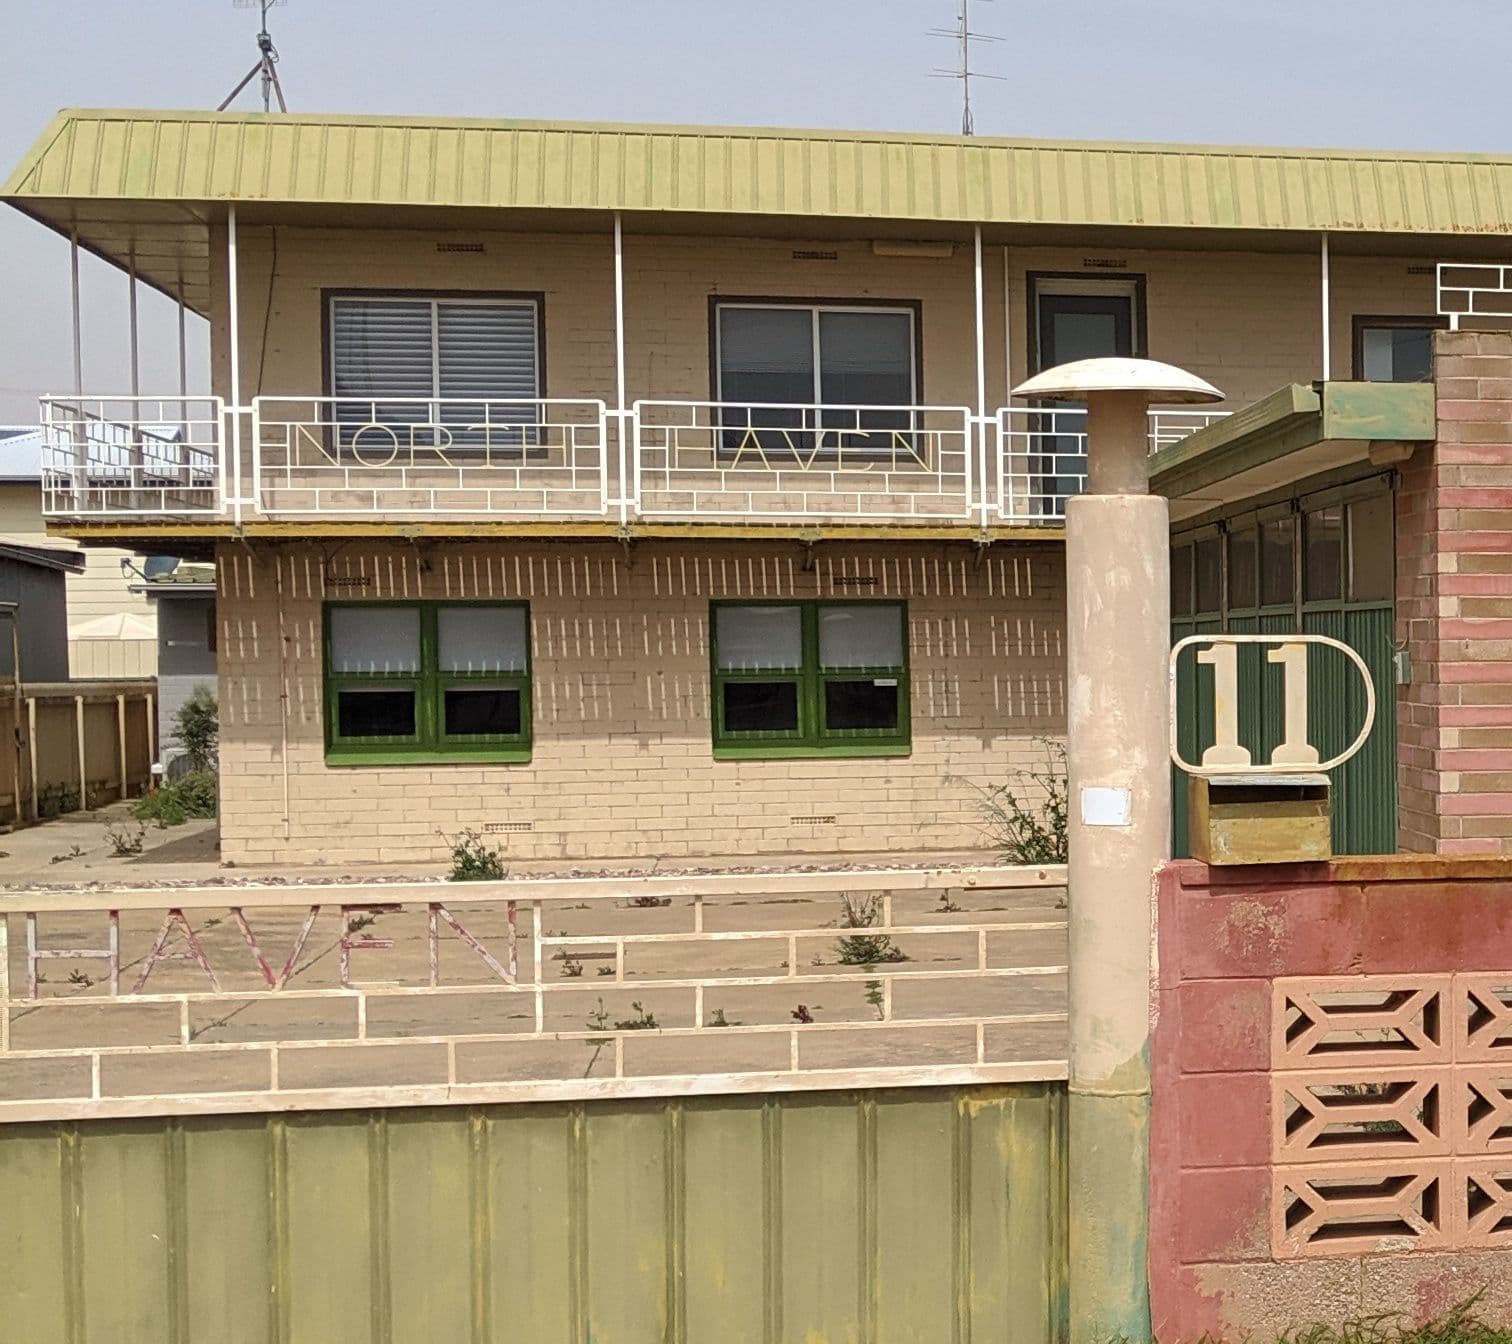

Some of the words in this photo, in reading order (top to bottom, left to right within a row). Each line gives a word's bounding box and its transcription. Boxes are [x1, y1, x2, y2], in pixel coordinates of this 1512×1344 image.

[675, 426, 934, 473] HAVEN
[1197, 642, 1320, 768] 11
[27, 901, 517, 998] HAVEN
